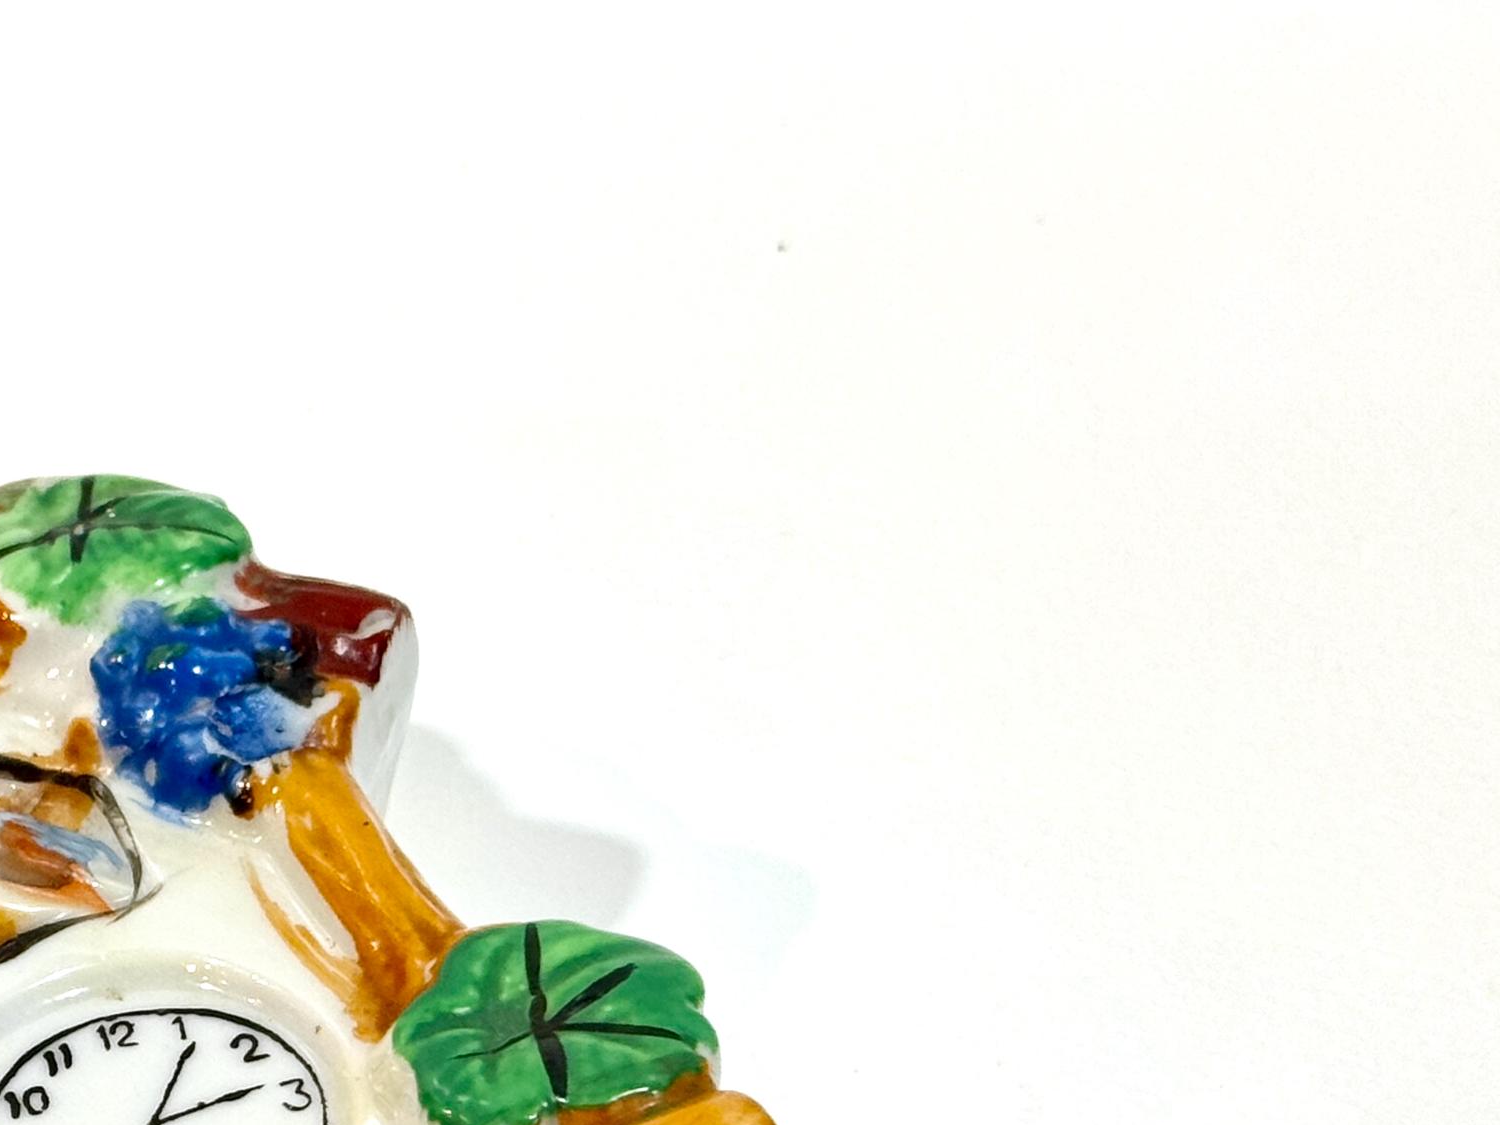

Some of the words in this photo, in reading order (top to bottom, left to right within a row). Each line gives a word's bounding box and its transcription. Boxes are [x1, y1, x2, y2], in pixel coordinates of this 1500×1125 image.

[96, 1020, 140, 1051] 12
[171, 1016, 187, 1040] 1
[43, 1043, 73, 1077] 11
[230, 1033, 270, 1062] 2
[3, 1085, 49, 1119] 10
[279, 1078, 312, 1111] 3
